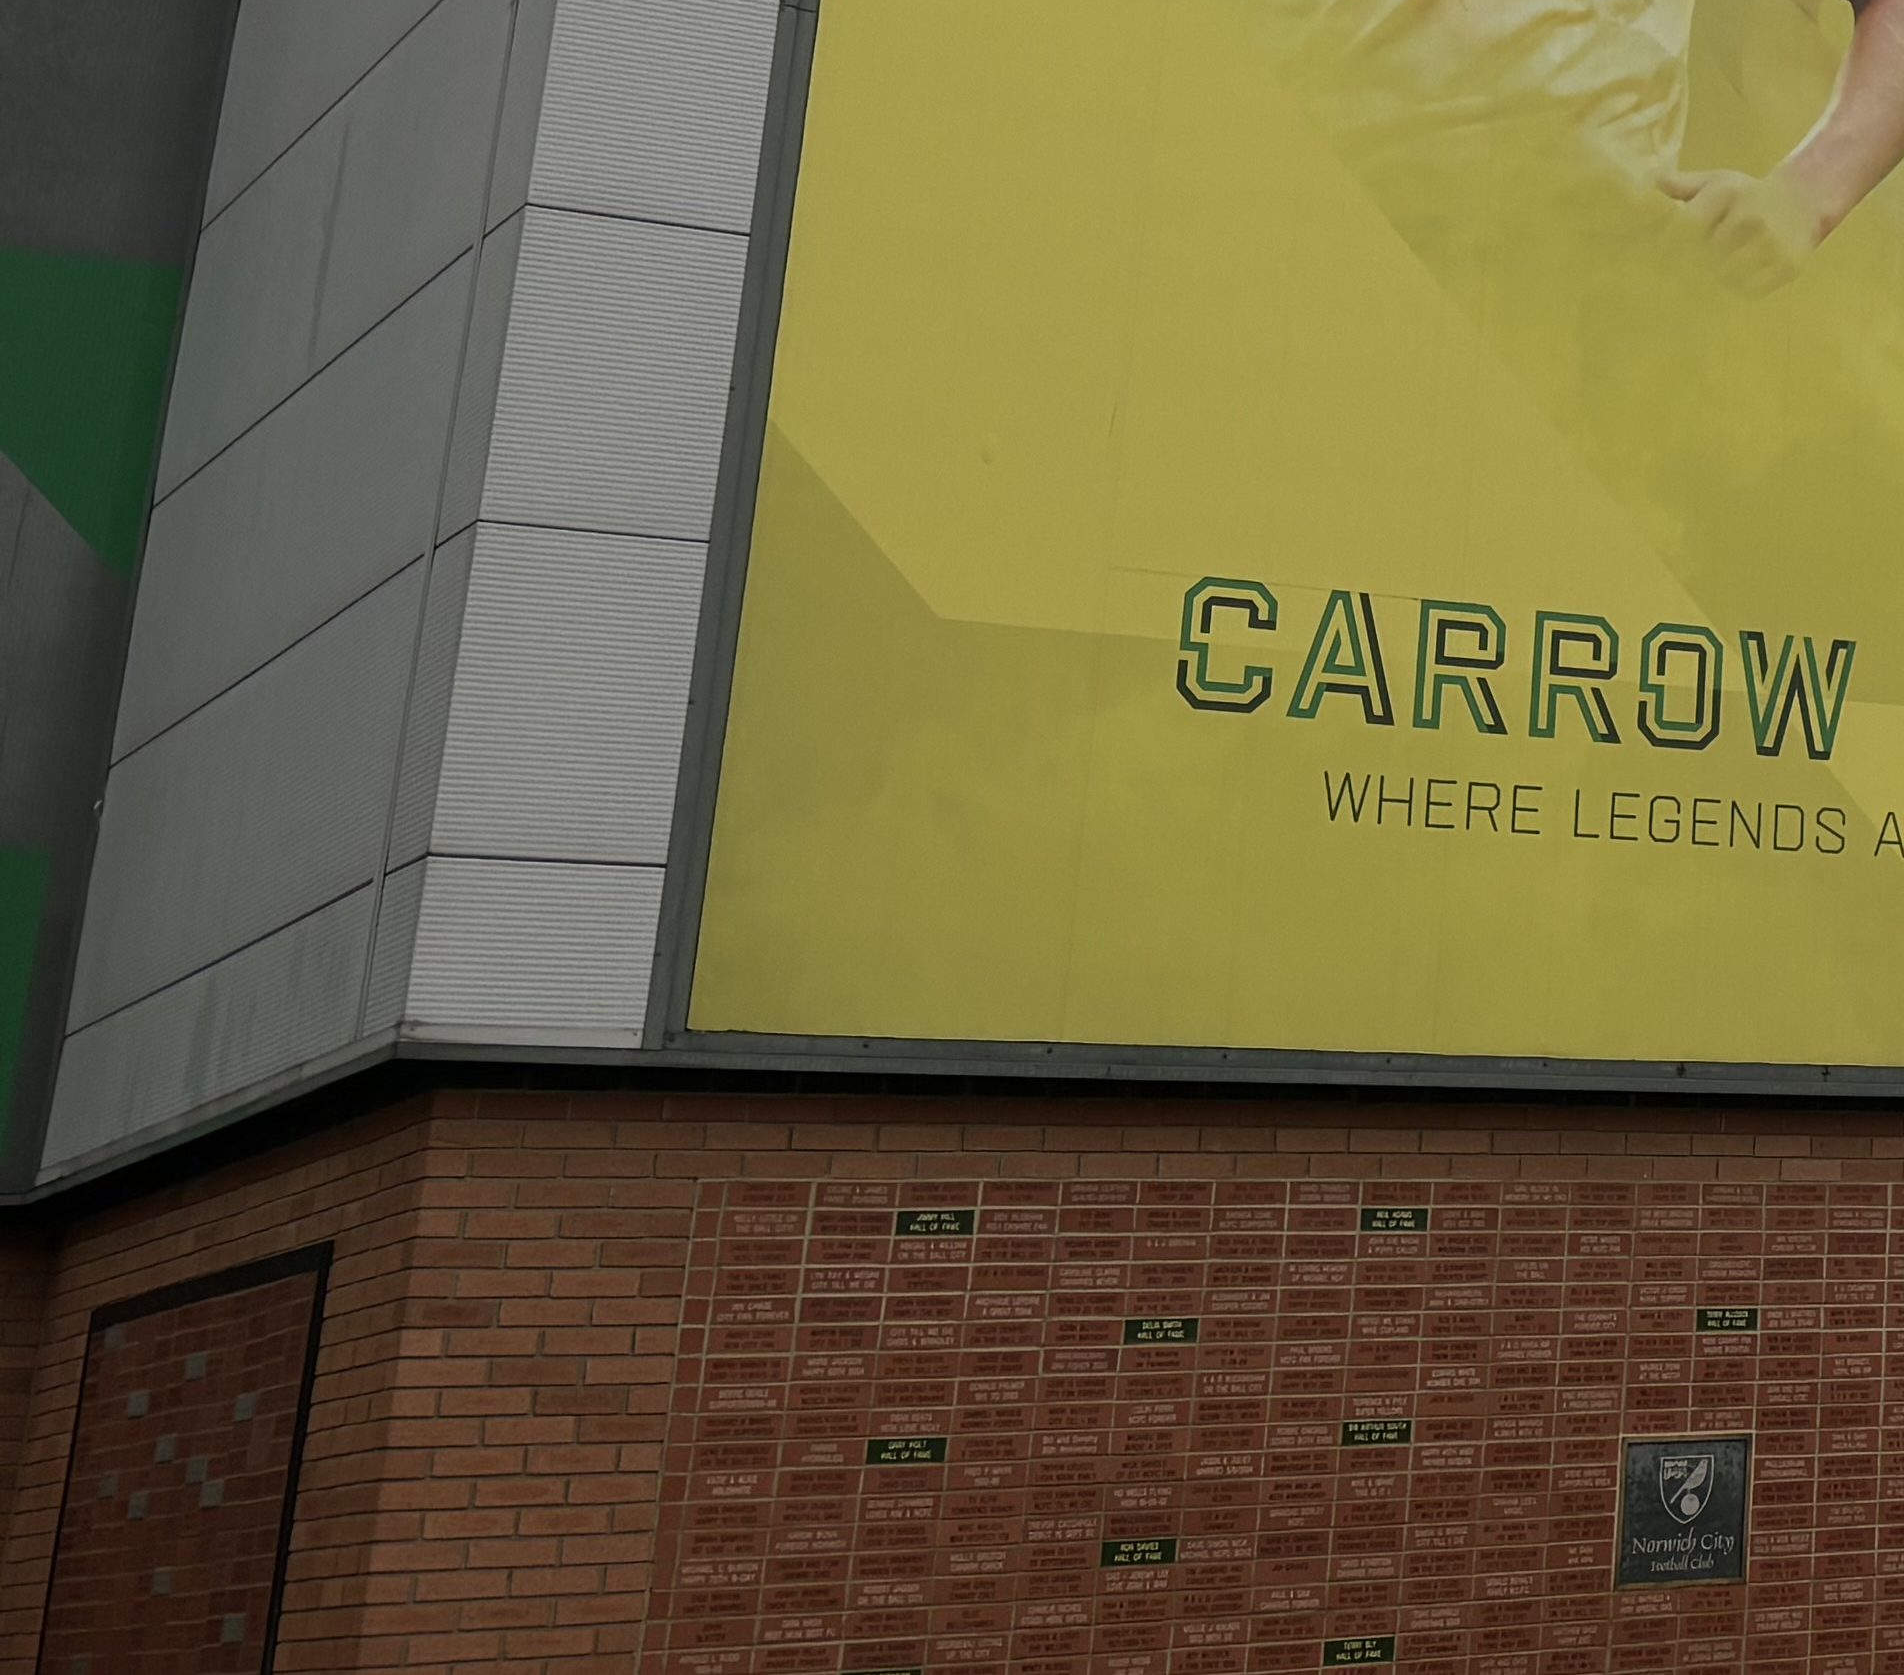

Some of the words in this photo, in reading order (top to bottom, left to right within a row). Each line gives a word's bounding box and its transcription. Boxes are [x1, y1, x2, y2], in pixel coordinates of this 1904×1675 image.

[1176, 576, 1857, 761] CARROW
[1323, 770, 1543, 836] WHERE
[1573, 788, 1846, 855] LEGENDS
[1632, 1527, 1697, 1557] Norwich
[1700, 1532, 1735, 1556] City
[1690, 1554, 1714, 1570] Club
